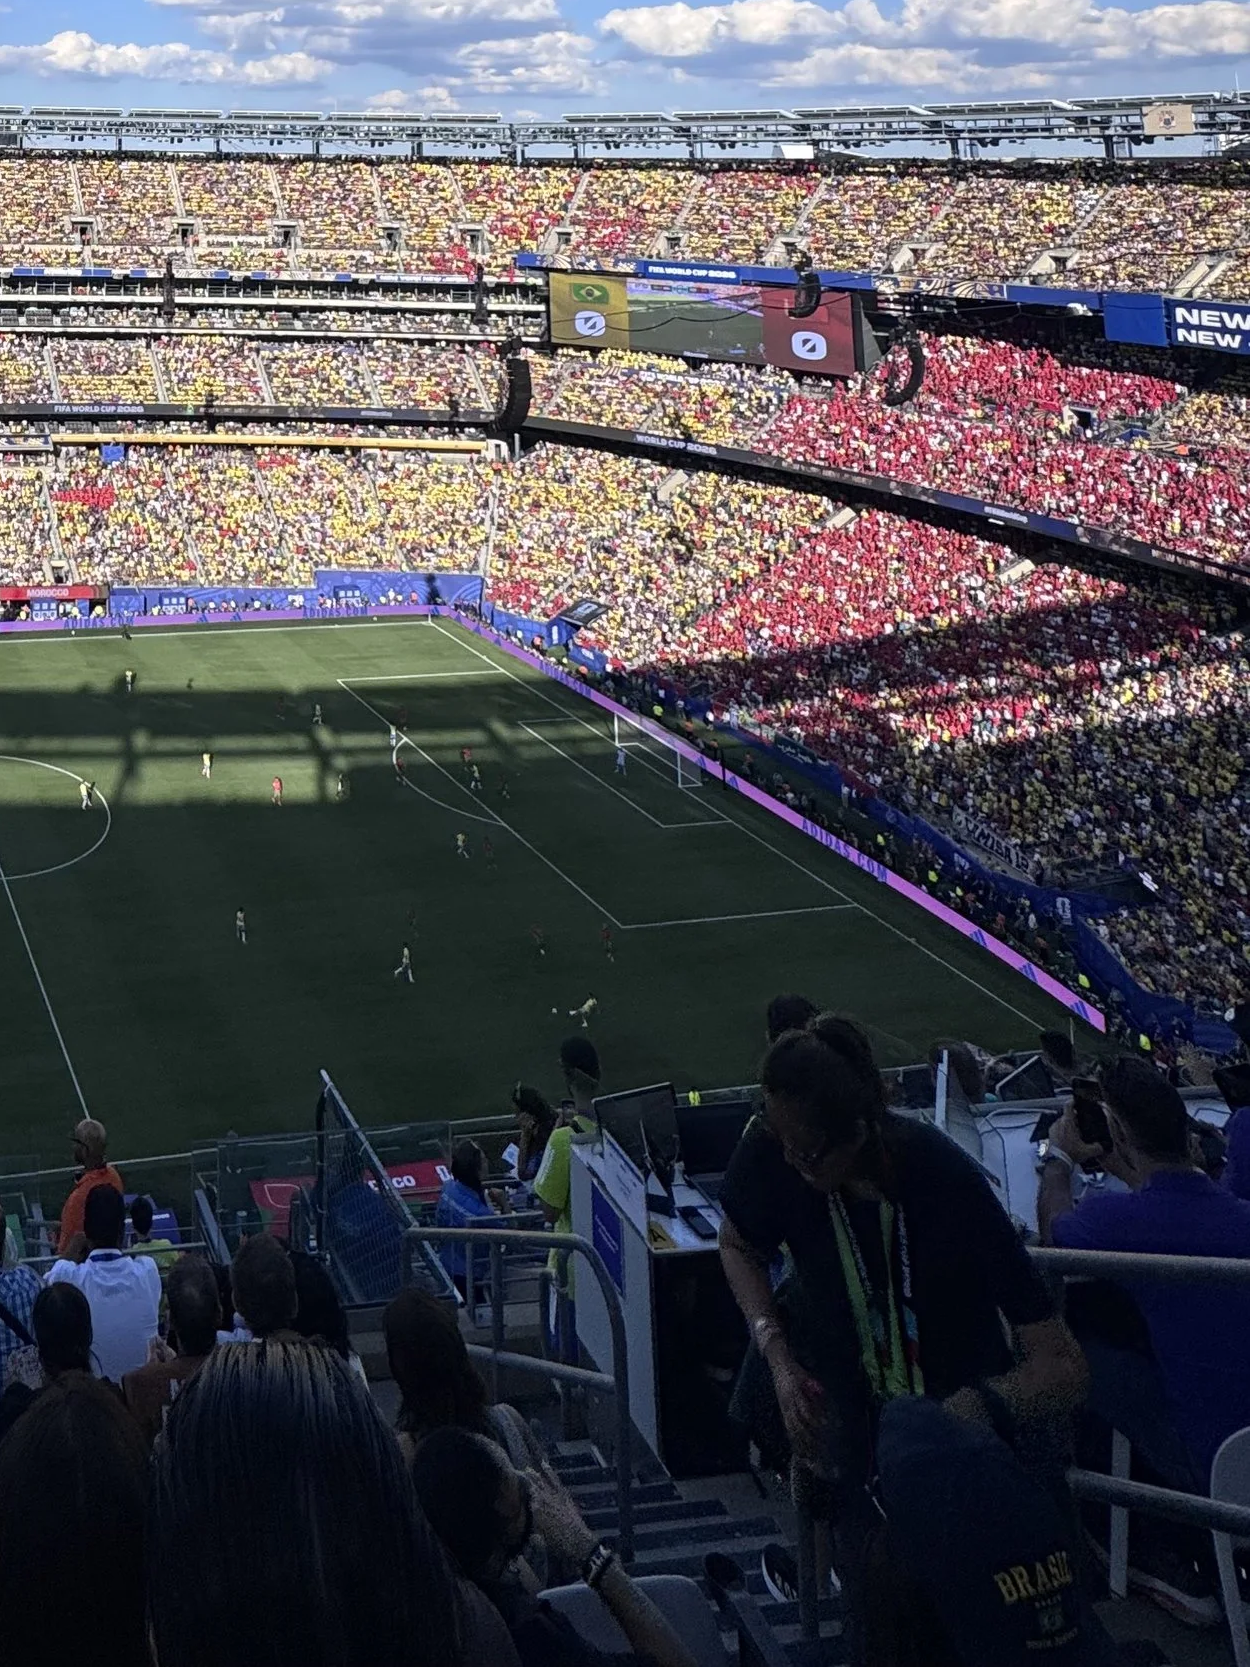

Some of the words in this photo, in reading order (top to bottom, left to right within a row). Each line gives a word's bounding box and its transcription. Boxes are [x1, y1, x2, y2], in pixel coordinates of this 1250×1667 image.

[1175, 307, 1250, 330] NEW
[1177, 329, 1242, 349] NEW
[55, 405, 71, 413] FIFA
[72, 405, 100, 413] WORLD
[637, 434, 667, 446] WORLD
[668, 439, 686, 449] CUP
[686, 443, 717, 455] 2026
[27, 588, 69, 597] MOROCCO
